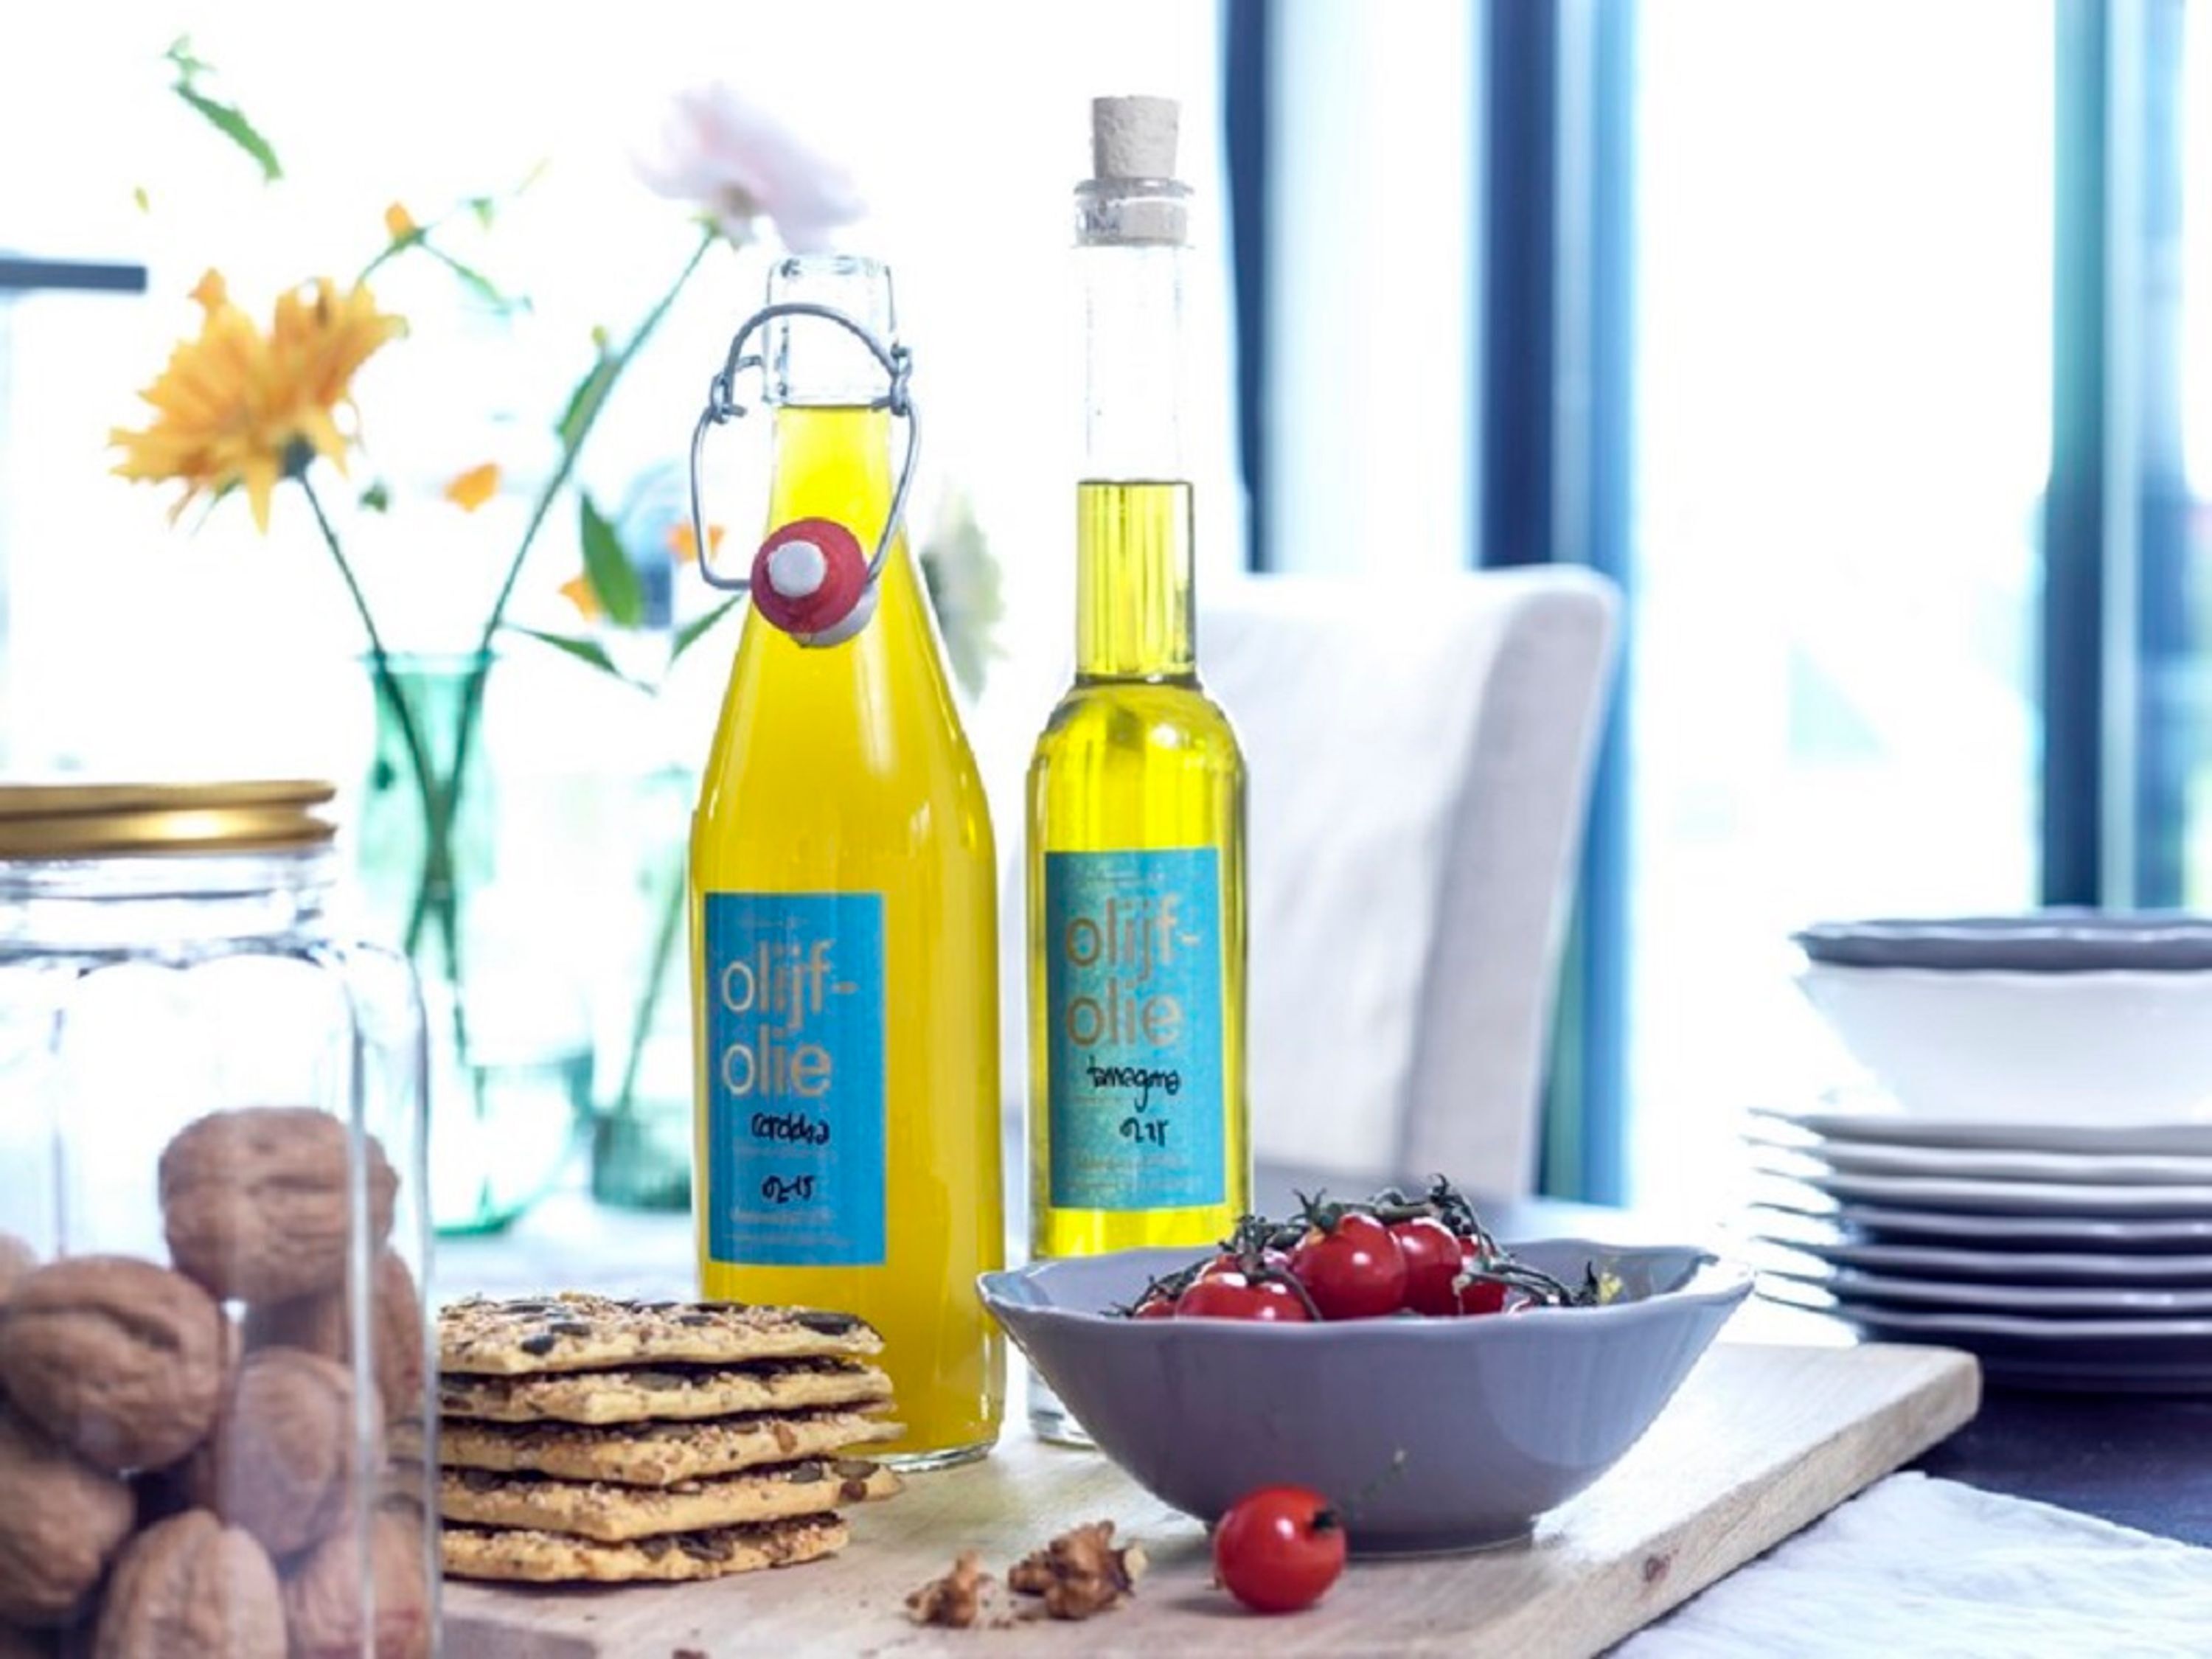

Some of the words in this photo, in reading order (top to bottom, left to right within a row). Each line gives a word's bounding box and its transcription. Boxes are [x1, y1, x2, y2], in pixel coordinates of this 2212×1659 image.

[1067, 894, 1200, 982] olijf-
[722, 939, 858, 1030] olijf-
[1066, 978, 1180, 1046] olie
[722, 1022, 832, 1096] olie
